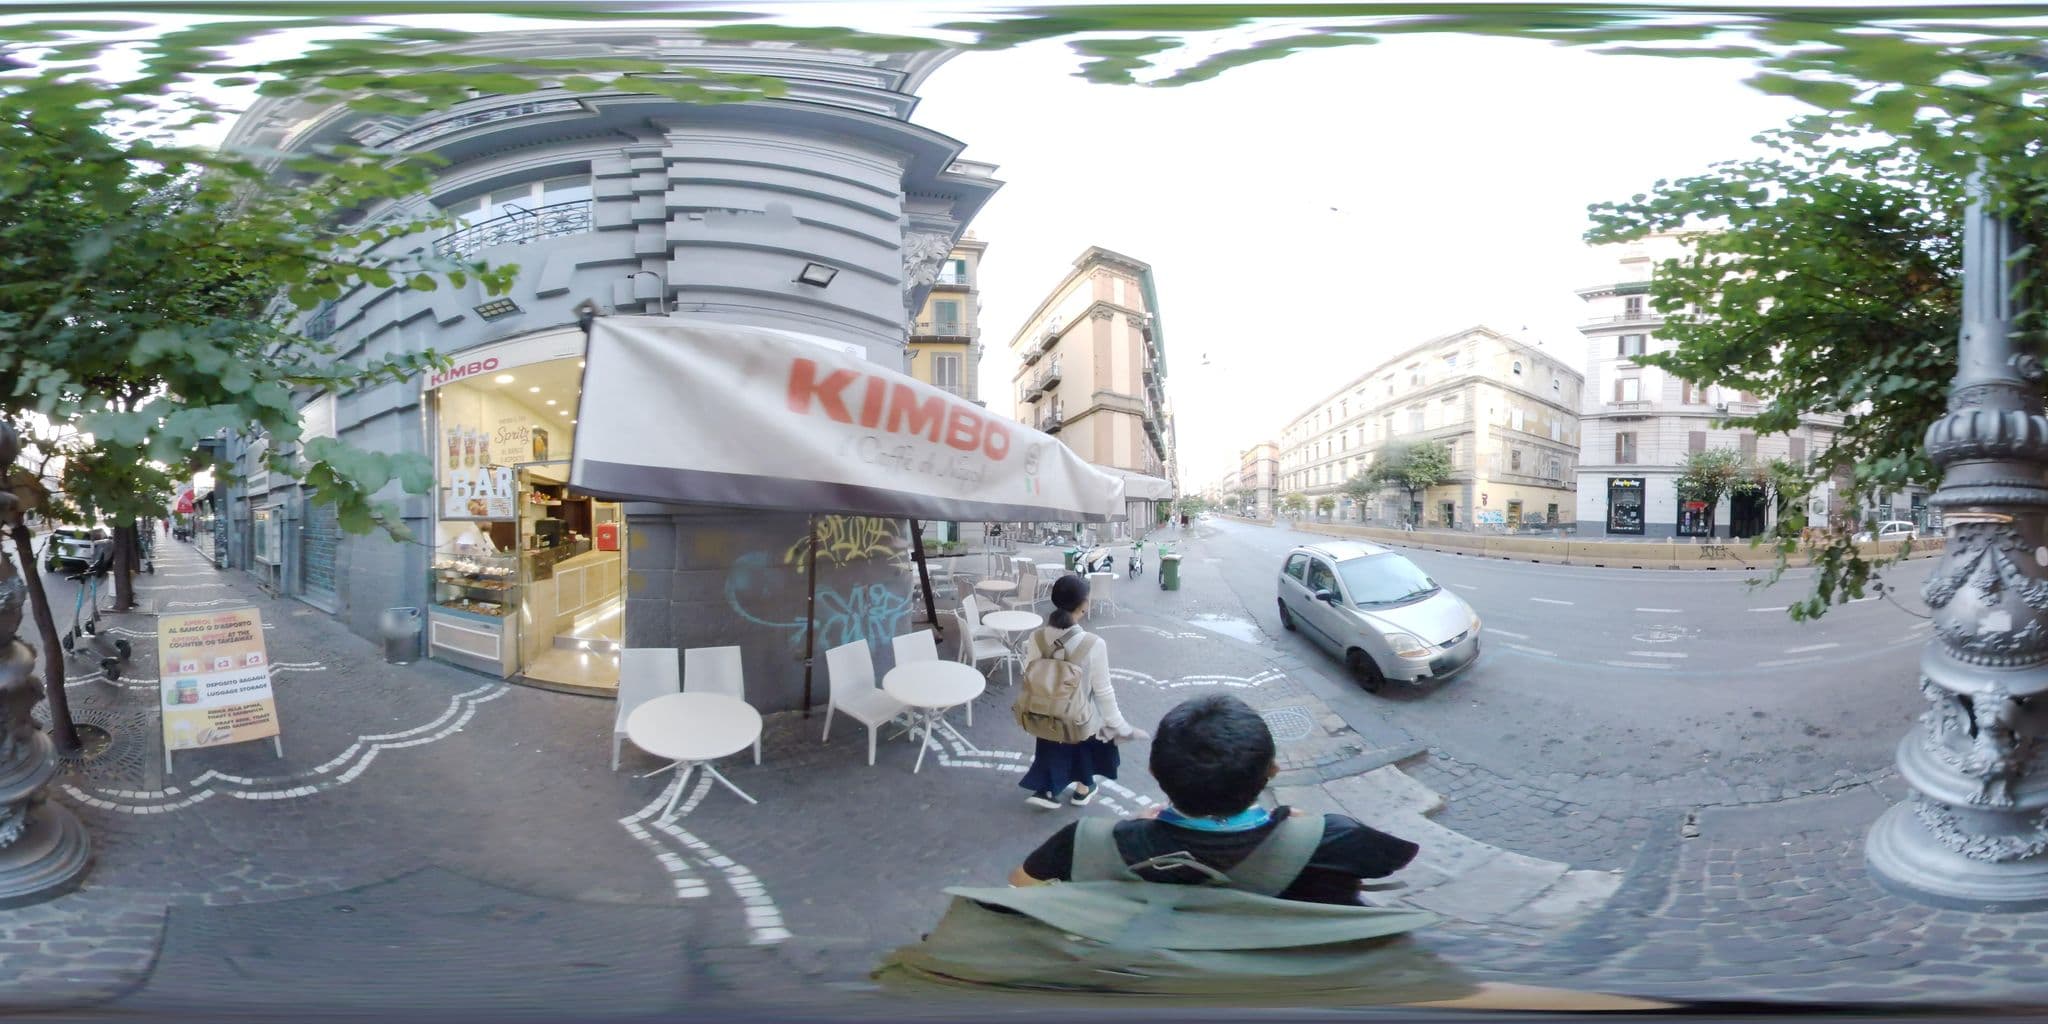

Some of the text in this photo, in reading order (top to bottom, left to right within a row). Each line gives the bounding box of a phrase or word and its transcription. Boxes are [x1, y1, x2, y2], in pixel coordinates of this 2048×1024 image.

[431, 358, 499, 386] KIMBO
[786, 357, 1011, 461] KIMBO
[495, 426, 530, 445] Spritz
[451, 467, 513, 499] BAR
[179, 625, 205, 633] BANCO
[206, 680, 238, 688] DEPOSITO
[207, 684, 268, 697] LUGGAGE STORAGE
